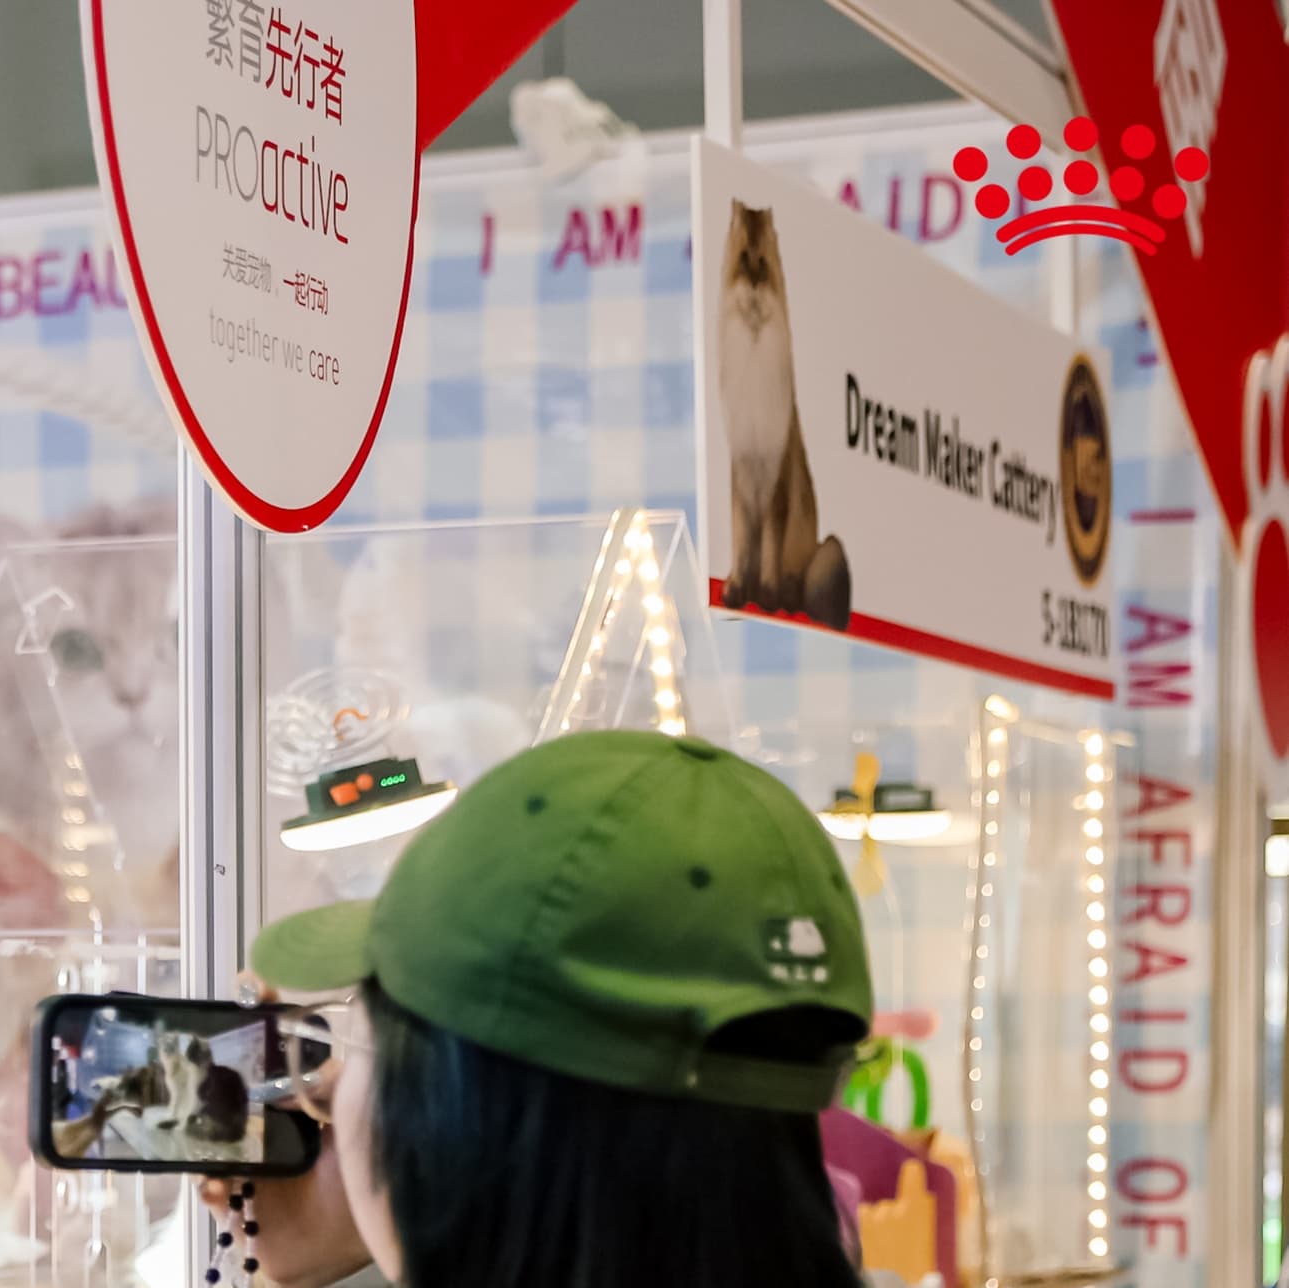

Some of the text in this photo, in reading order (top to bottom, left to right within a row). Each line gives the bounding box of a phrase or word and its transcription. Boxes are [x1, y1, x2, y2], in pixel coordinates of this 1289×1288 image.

[196, 105, 349, 244] PROactive
[480, 214, 495, 277] I
[553, 203, 645, 271] AM
[209, 306, 340, 386] together we care
[845, 372, 1060, 547] Dream Maker Cattery
[1124, 605, 1193, 710] AM
[1116, 773, 1192, 1097] AFRAID
[1113, 1157, 1191, 1259] OF
